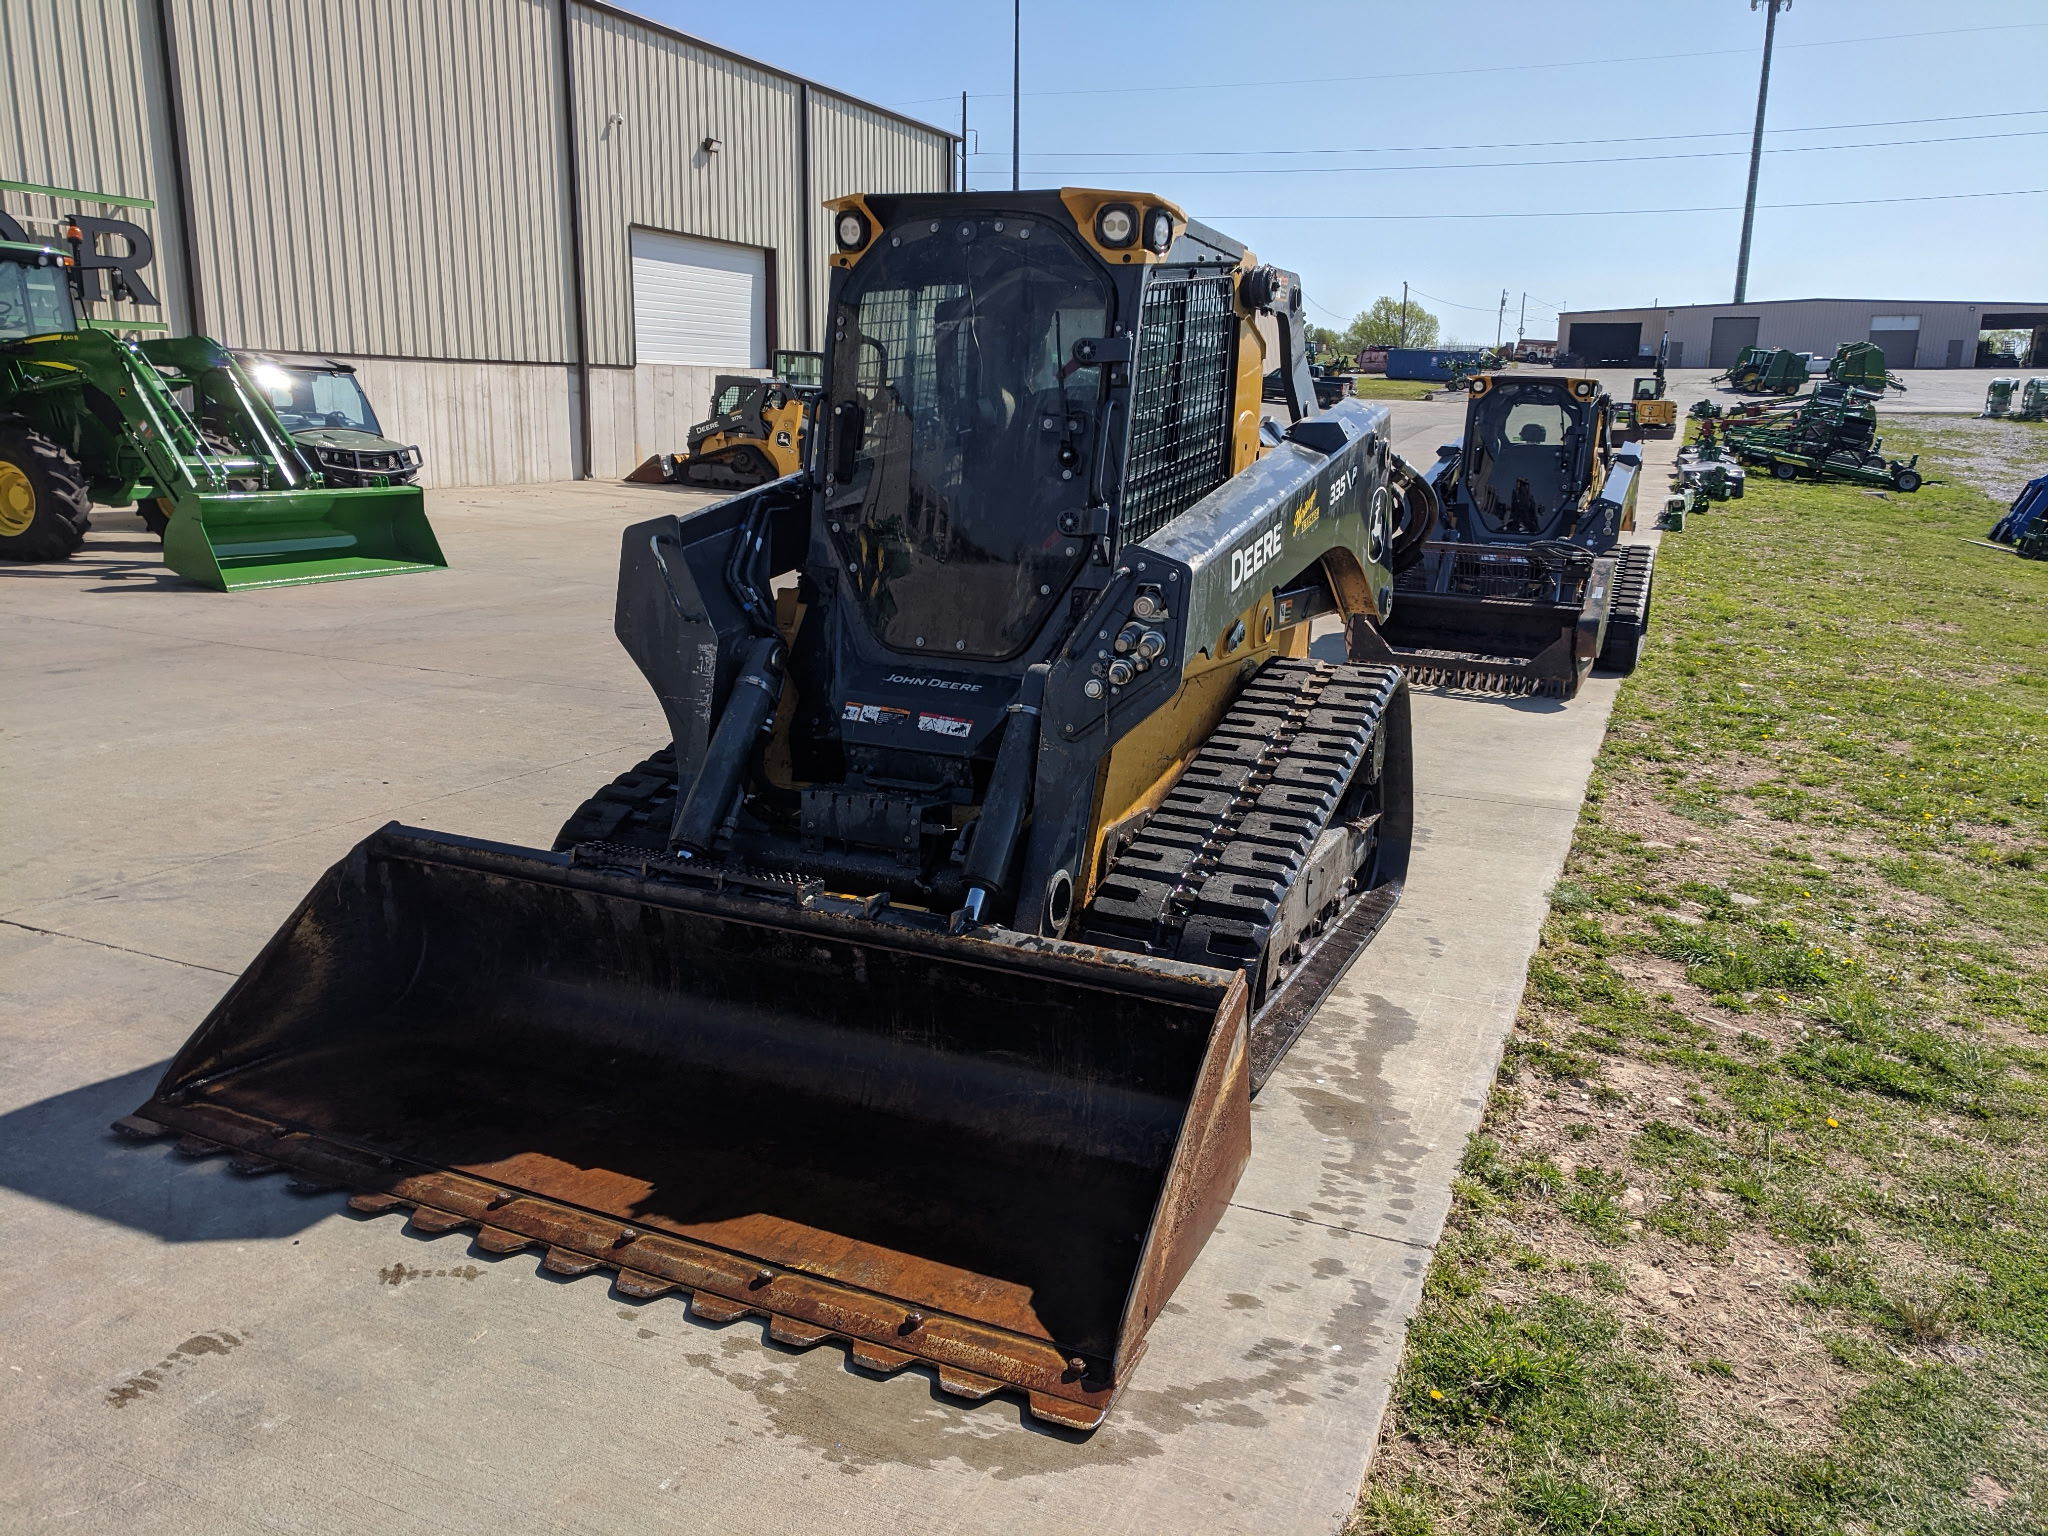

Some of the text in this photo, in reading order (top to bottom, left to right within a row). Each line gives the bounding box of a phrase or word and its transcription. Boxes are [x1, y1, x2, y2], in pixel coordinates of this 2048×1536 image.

[696, 421, 719, 434] DEERE
[1231, 521, 1283, 593] DEERE
[882, 673, 984, 692] JOHN DEERE
